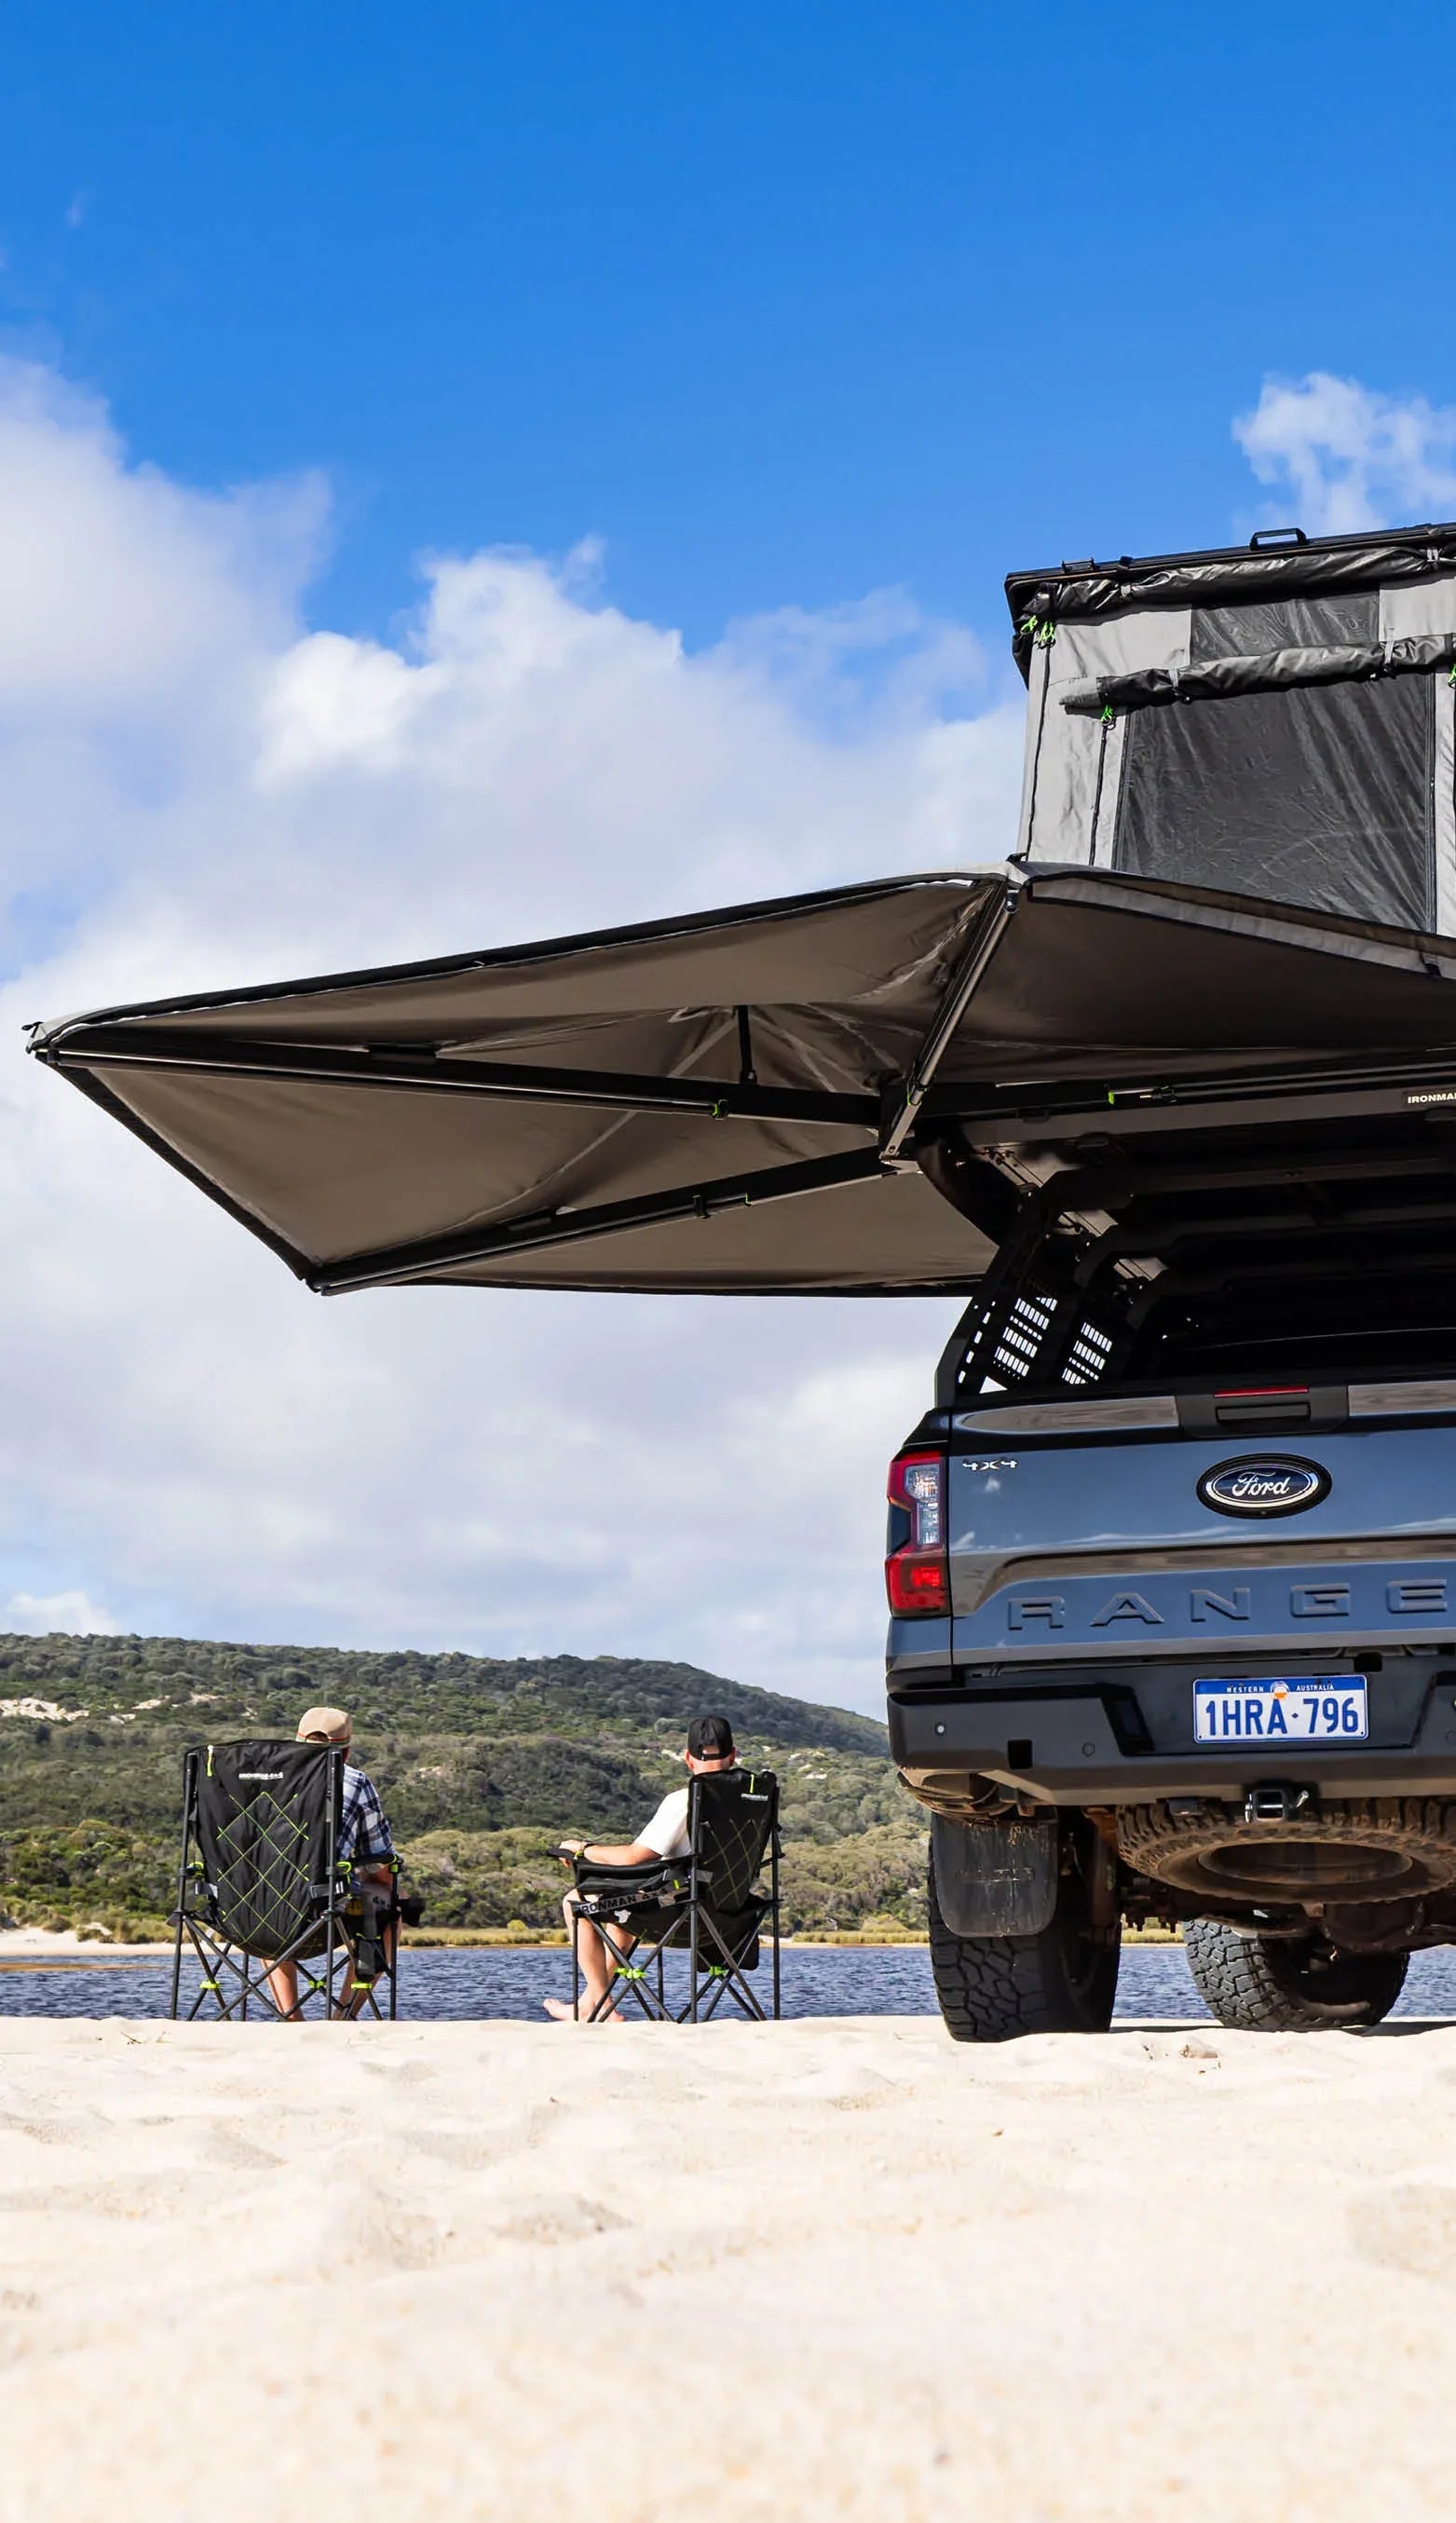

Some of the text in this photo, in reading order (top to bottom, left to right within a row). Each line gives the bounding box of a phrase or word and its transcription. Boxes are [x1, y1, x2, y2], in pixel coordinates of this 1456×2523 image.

[1231, 1471, 1290, 1496] Ford
[1226, 1684, 1334, 1694] WESTERN AUSTRALIA
